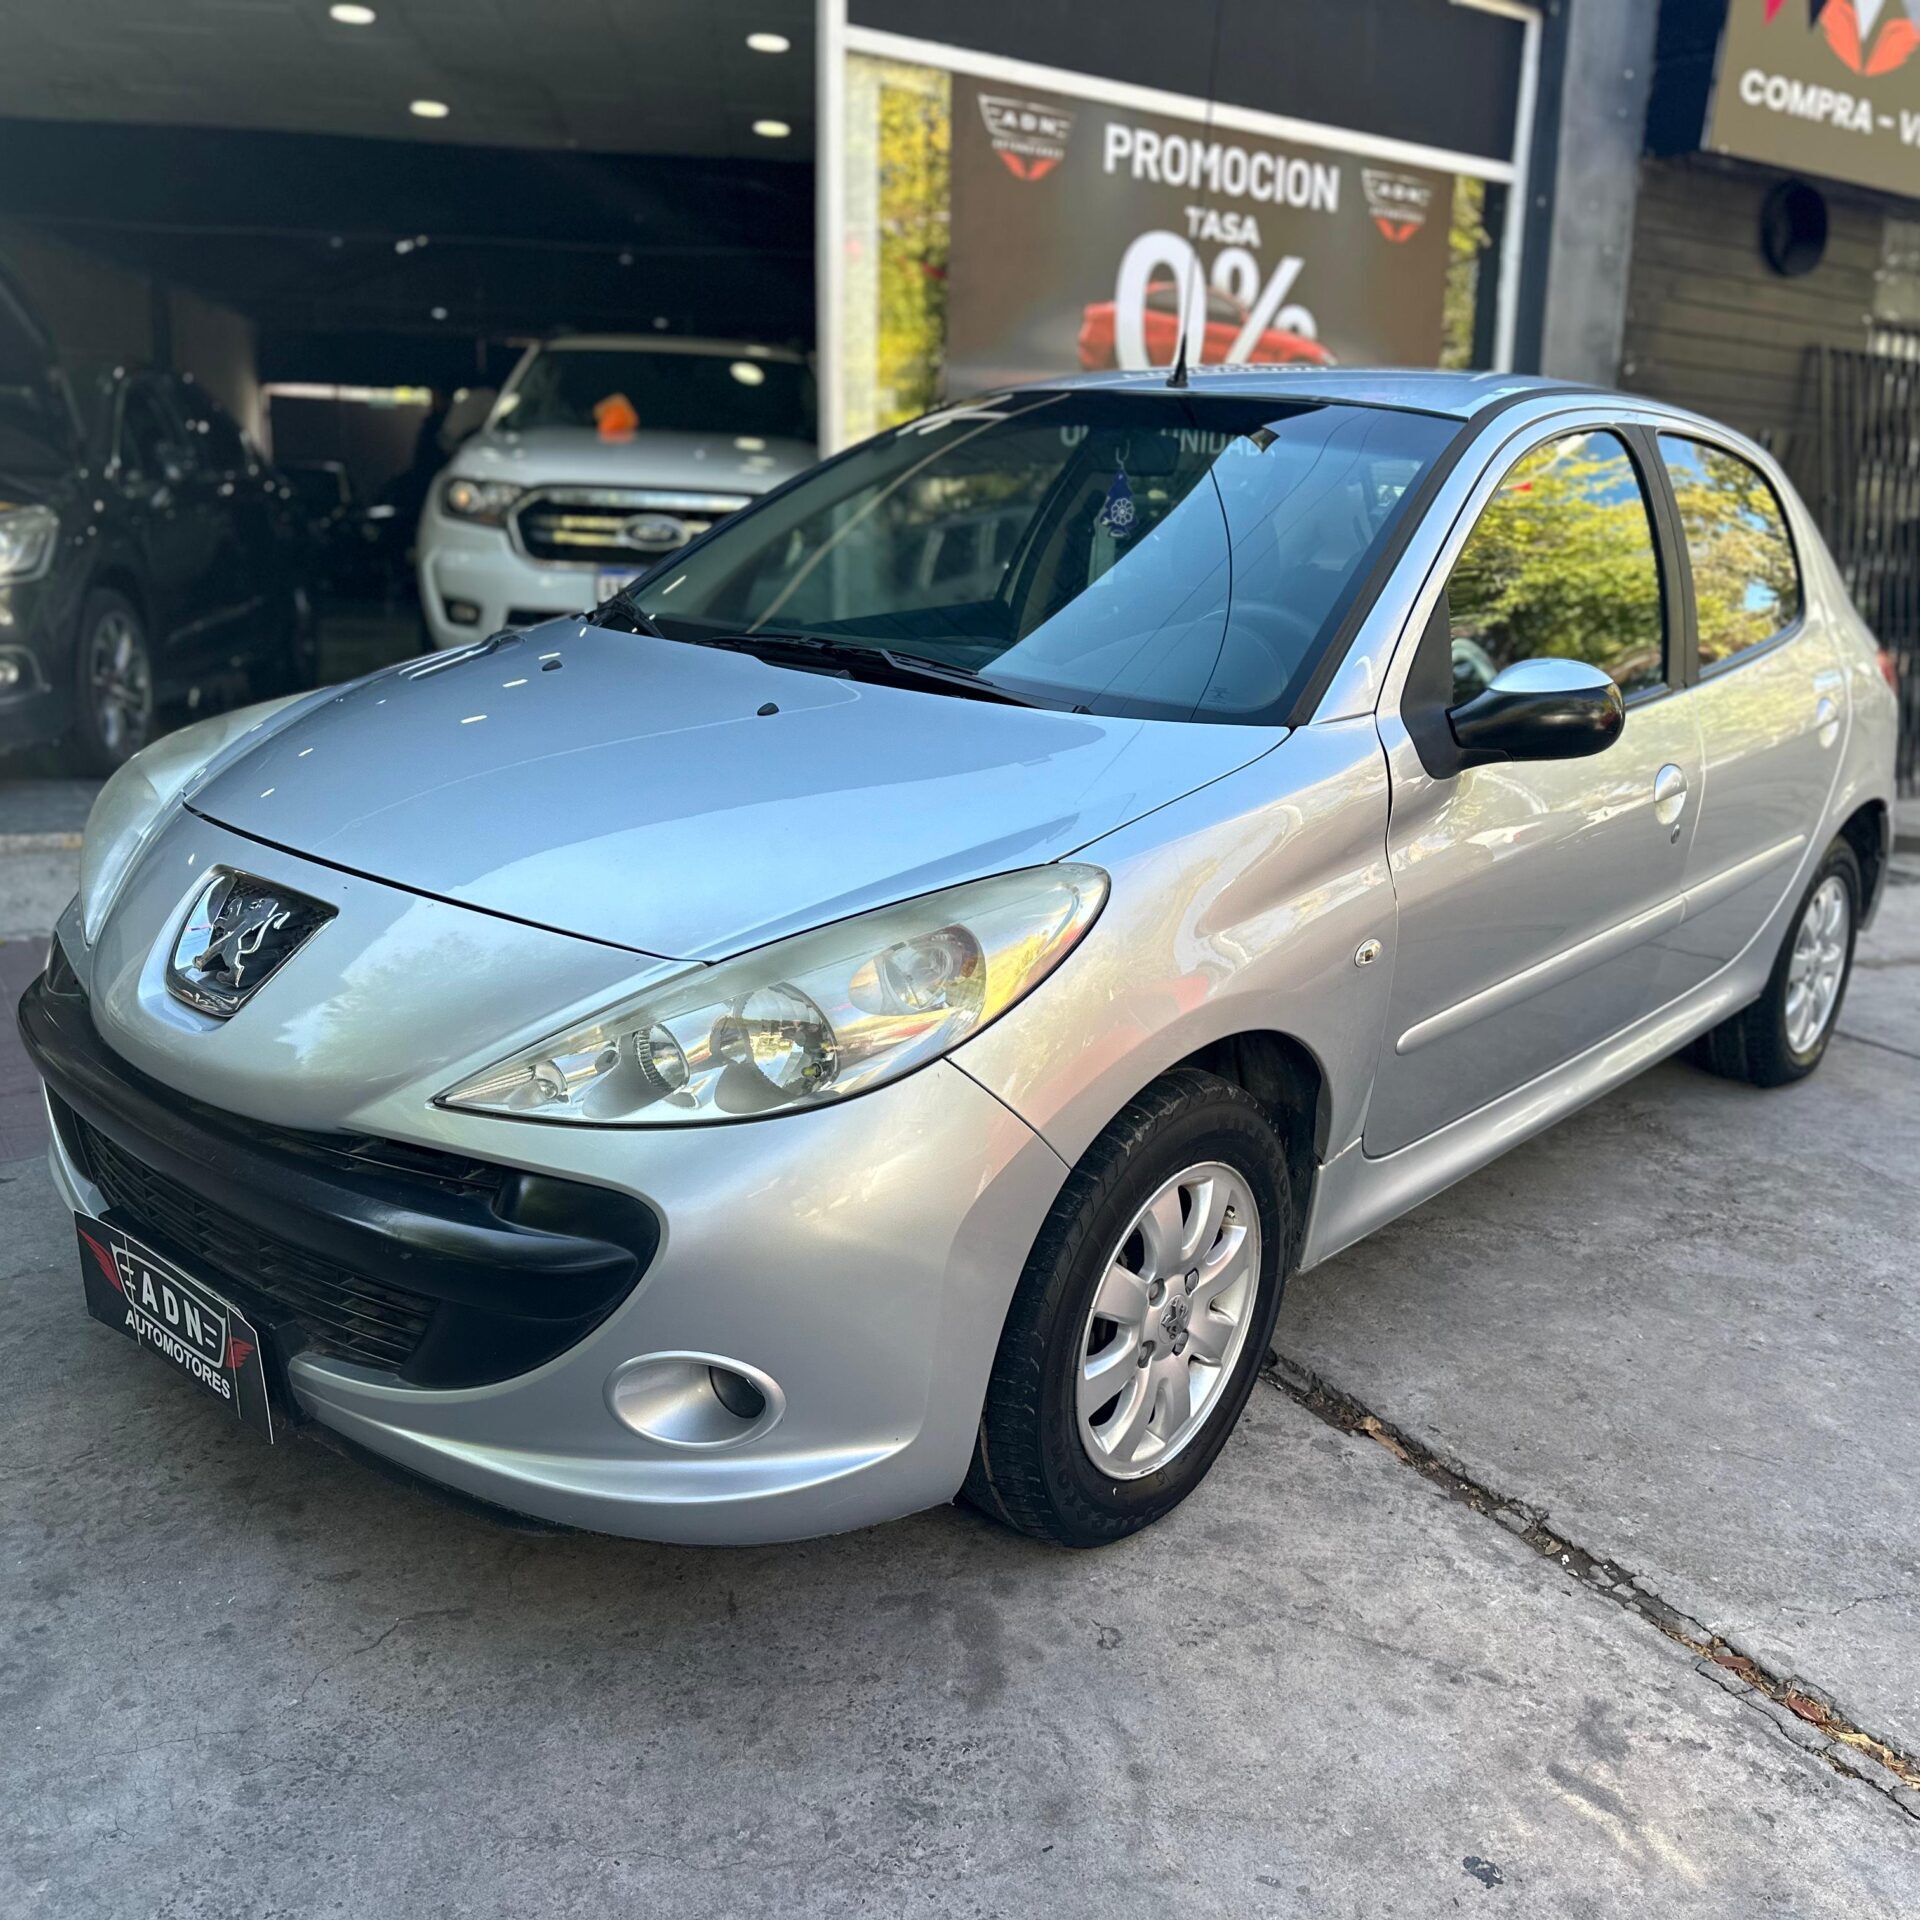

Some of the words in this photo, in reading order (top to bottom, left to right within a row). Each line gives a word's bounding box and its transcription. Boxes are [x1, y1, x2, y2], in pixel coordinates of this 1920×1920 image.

[1740, 69, 1873, 134] COMPRA
[1899, 109, 1920, 147] V
[1103, 122, 1341, 213] PROMOCION
[1184, 205, 1262, 248] TASA
[1114, 230, 1318, 371] 0%
[125, 1309, 231, 1399] AUTOMOTORES
